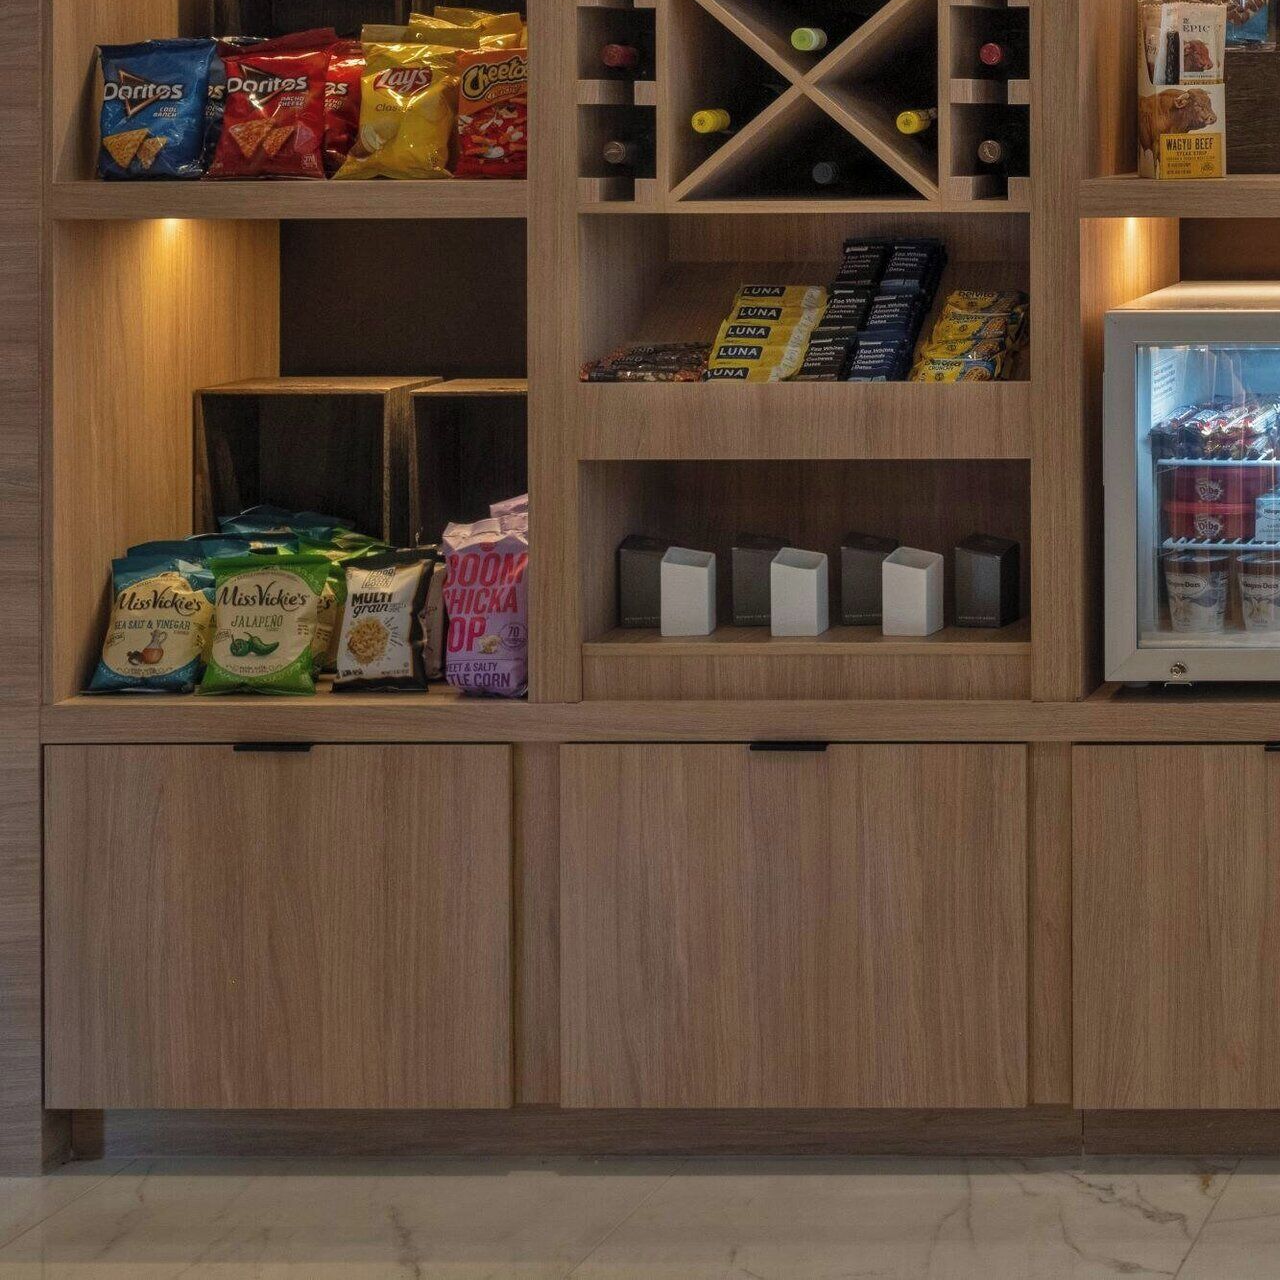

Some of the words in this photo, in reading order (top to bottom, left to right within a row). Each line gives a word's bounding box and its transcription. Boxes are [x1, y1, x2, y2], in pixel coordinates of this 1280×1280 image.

[1183, 24, 1211, 33] EPIC
[103, 82, 184, 100] Doritos
[227, 76, 308, 94] Doritos
[1166, 138, 1191, 151] WAGYU
[1194, 137, 1214, 150] BEEF
[743, 287, 781, 295] LUNA
[740, 307, 777, 317] LUNA
[728, 326, 766, 336] LUNA
[720, 346, 758, 356] LUNA
[1198, 521, 1219, 532] Dibs
[218, 586, 256, 607] Miss
[255, 580, 308, 612] Vickie's
[351, 592, 392, 606] MULTI
[354, 603, 389, 618] grain
[127, 620, 145, 630] SALT
[156, 619, 190, 631] VINEGAR
[448, 616, 487, 653] OP
[472, 662, 497, 672] SALTY
[473, 672, 511, 687] CORN
